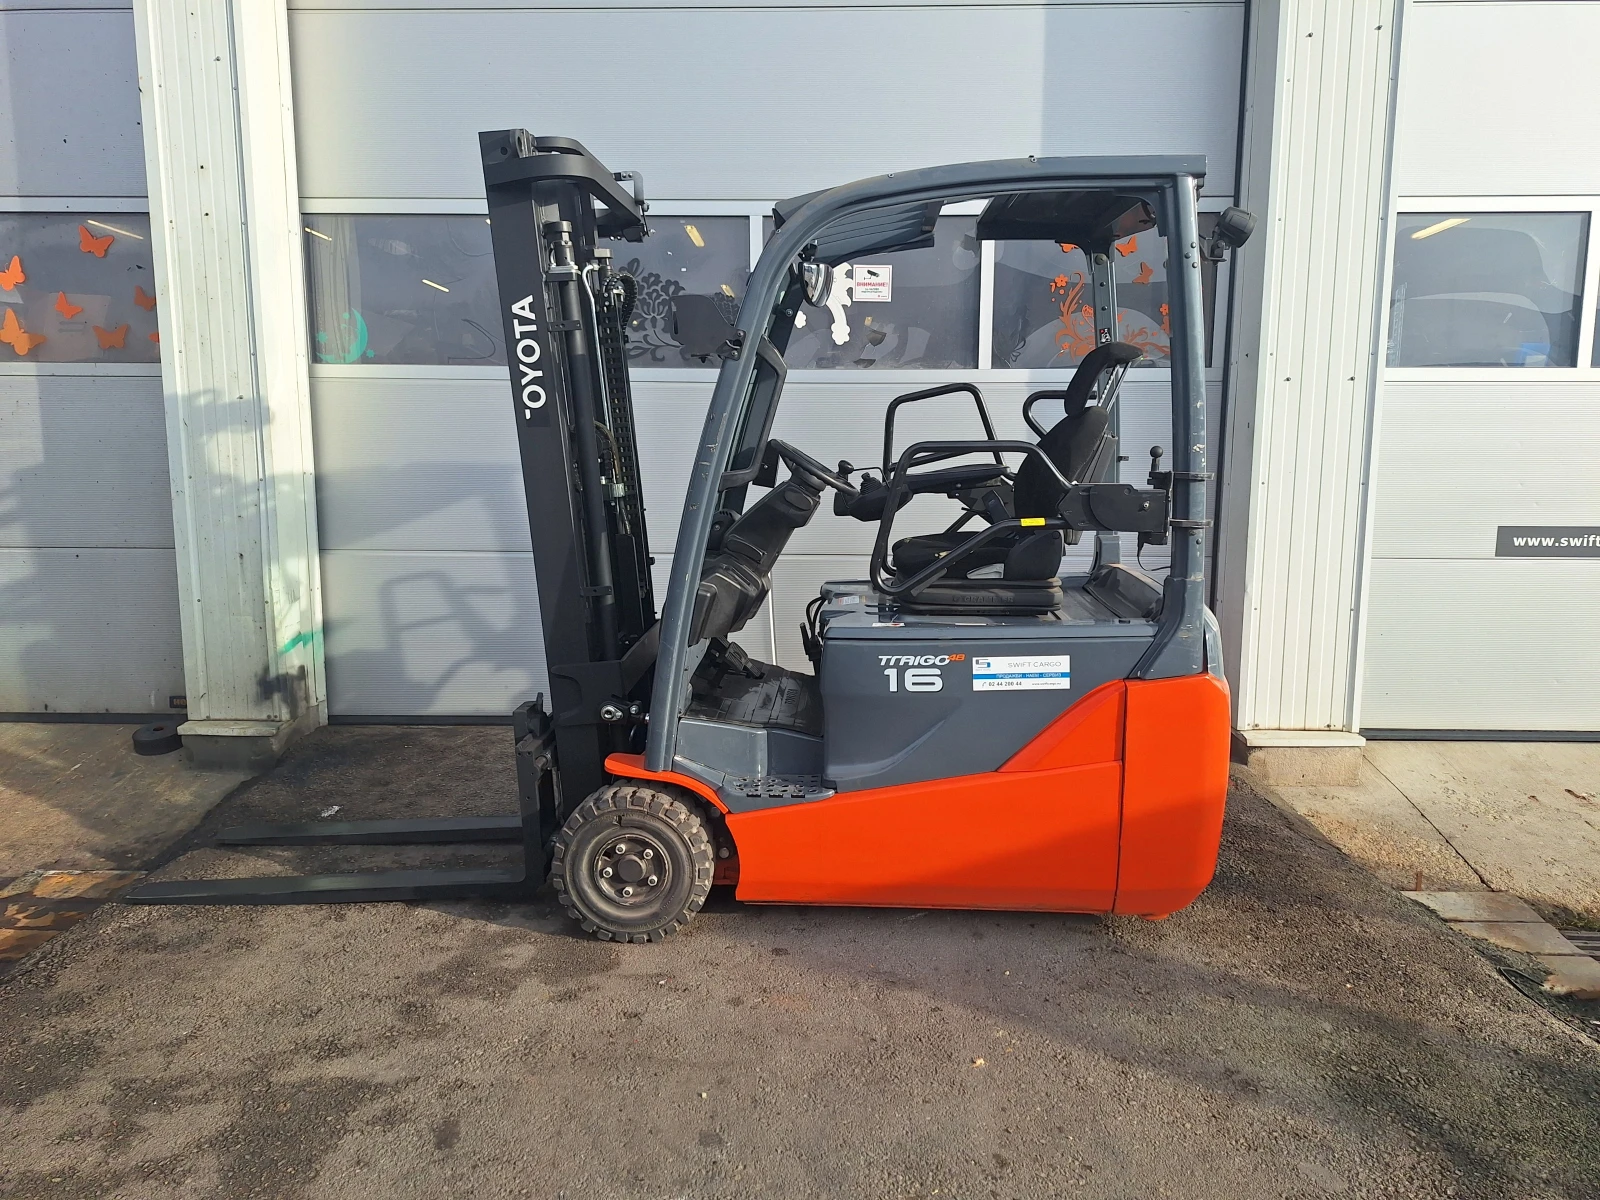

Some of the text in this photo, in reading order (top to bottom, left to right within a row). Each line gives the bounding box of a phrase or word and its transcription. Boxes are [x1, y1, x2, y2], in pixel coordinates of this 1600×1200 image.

[511, 294, 547, 420] OYOTA
[1513, 535, 1600, 547] www.swift
[883, 668, 943, 692] 16
